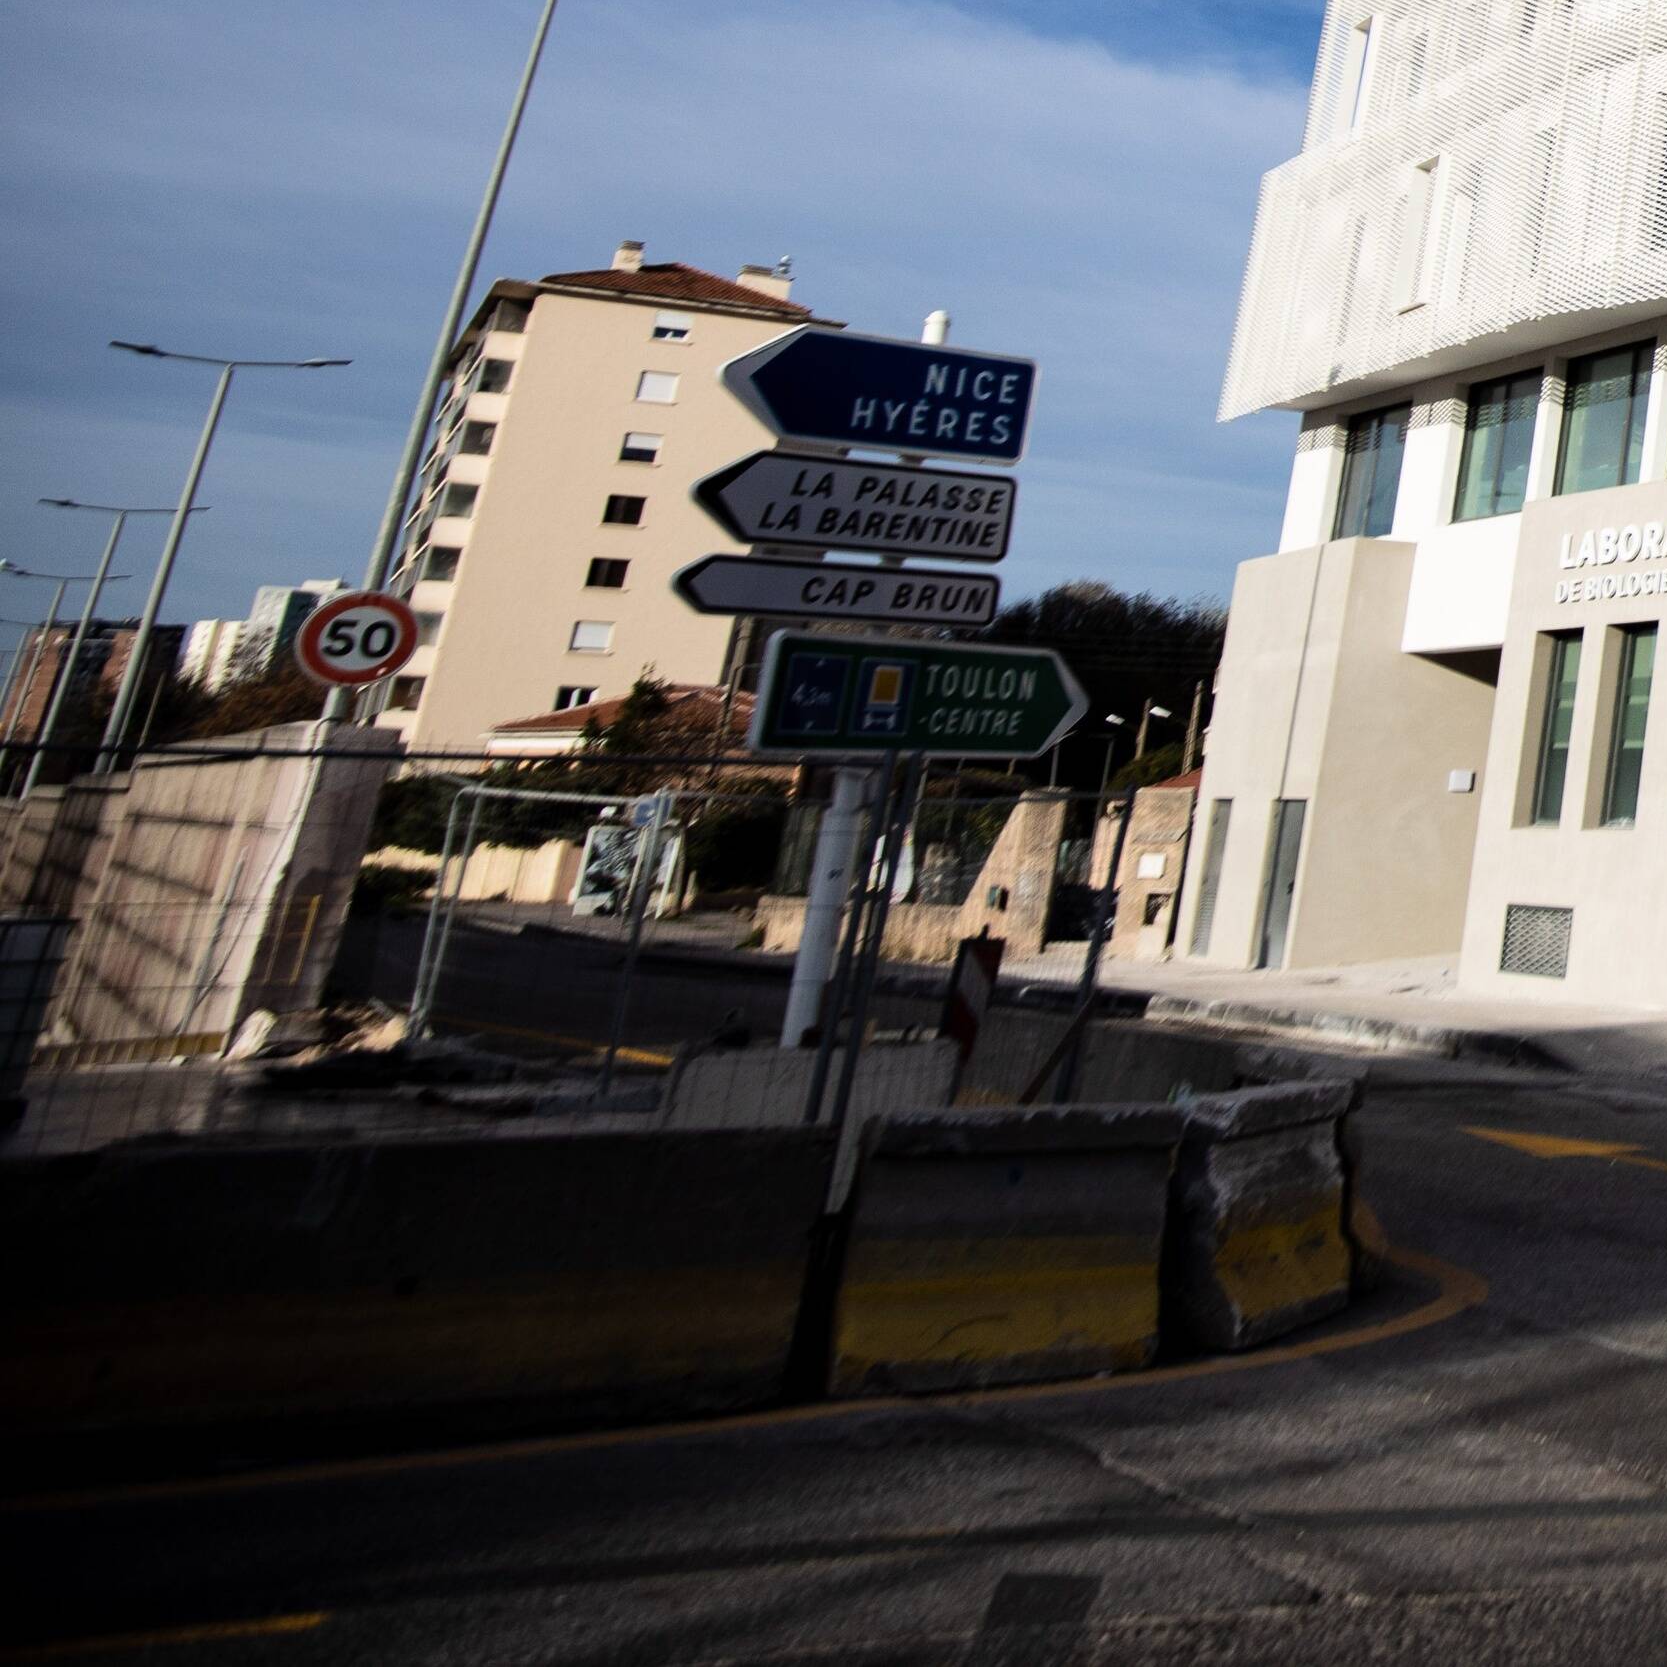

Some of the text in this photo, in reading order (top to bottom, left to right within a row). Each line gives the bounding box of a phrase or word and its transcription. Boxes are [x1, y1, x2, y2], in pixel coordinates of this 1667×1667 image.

[924, 363, 1019, 404] NICE
[790, 469, 1006, 515] LA PALASSE
[758, 501, 1001, 548] LA BARENTINE
[801, 577, 990, 614] CAP BRUN
[1555, 580, 1583, 604] DE
[323, 619, 396, 658] 50
[925, 664, 1039, 702] TOULON
